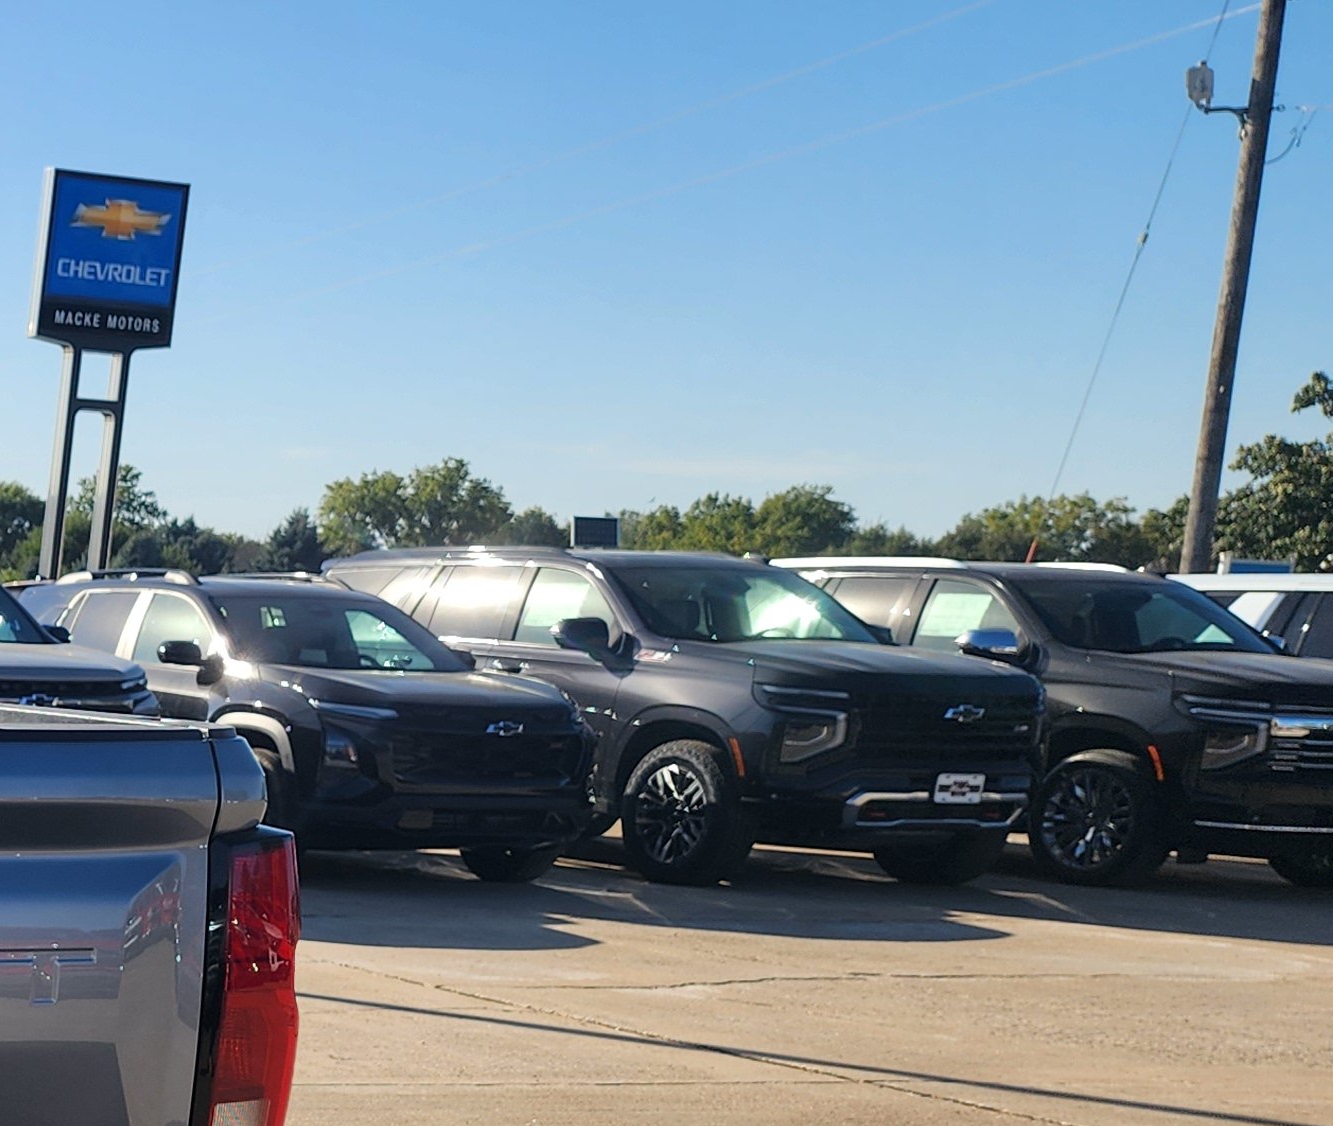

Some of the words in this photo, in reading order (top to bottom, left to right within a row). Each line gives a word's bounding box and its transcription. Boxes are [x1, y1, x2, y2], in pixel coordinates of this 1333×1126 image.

[57, 257, 170, 287] CHEVROLET
[54, 309, 100, 328] MACKE
[107, 314, 160, 333] MOTORS
